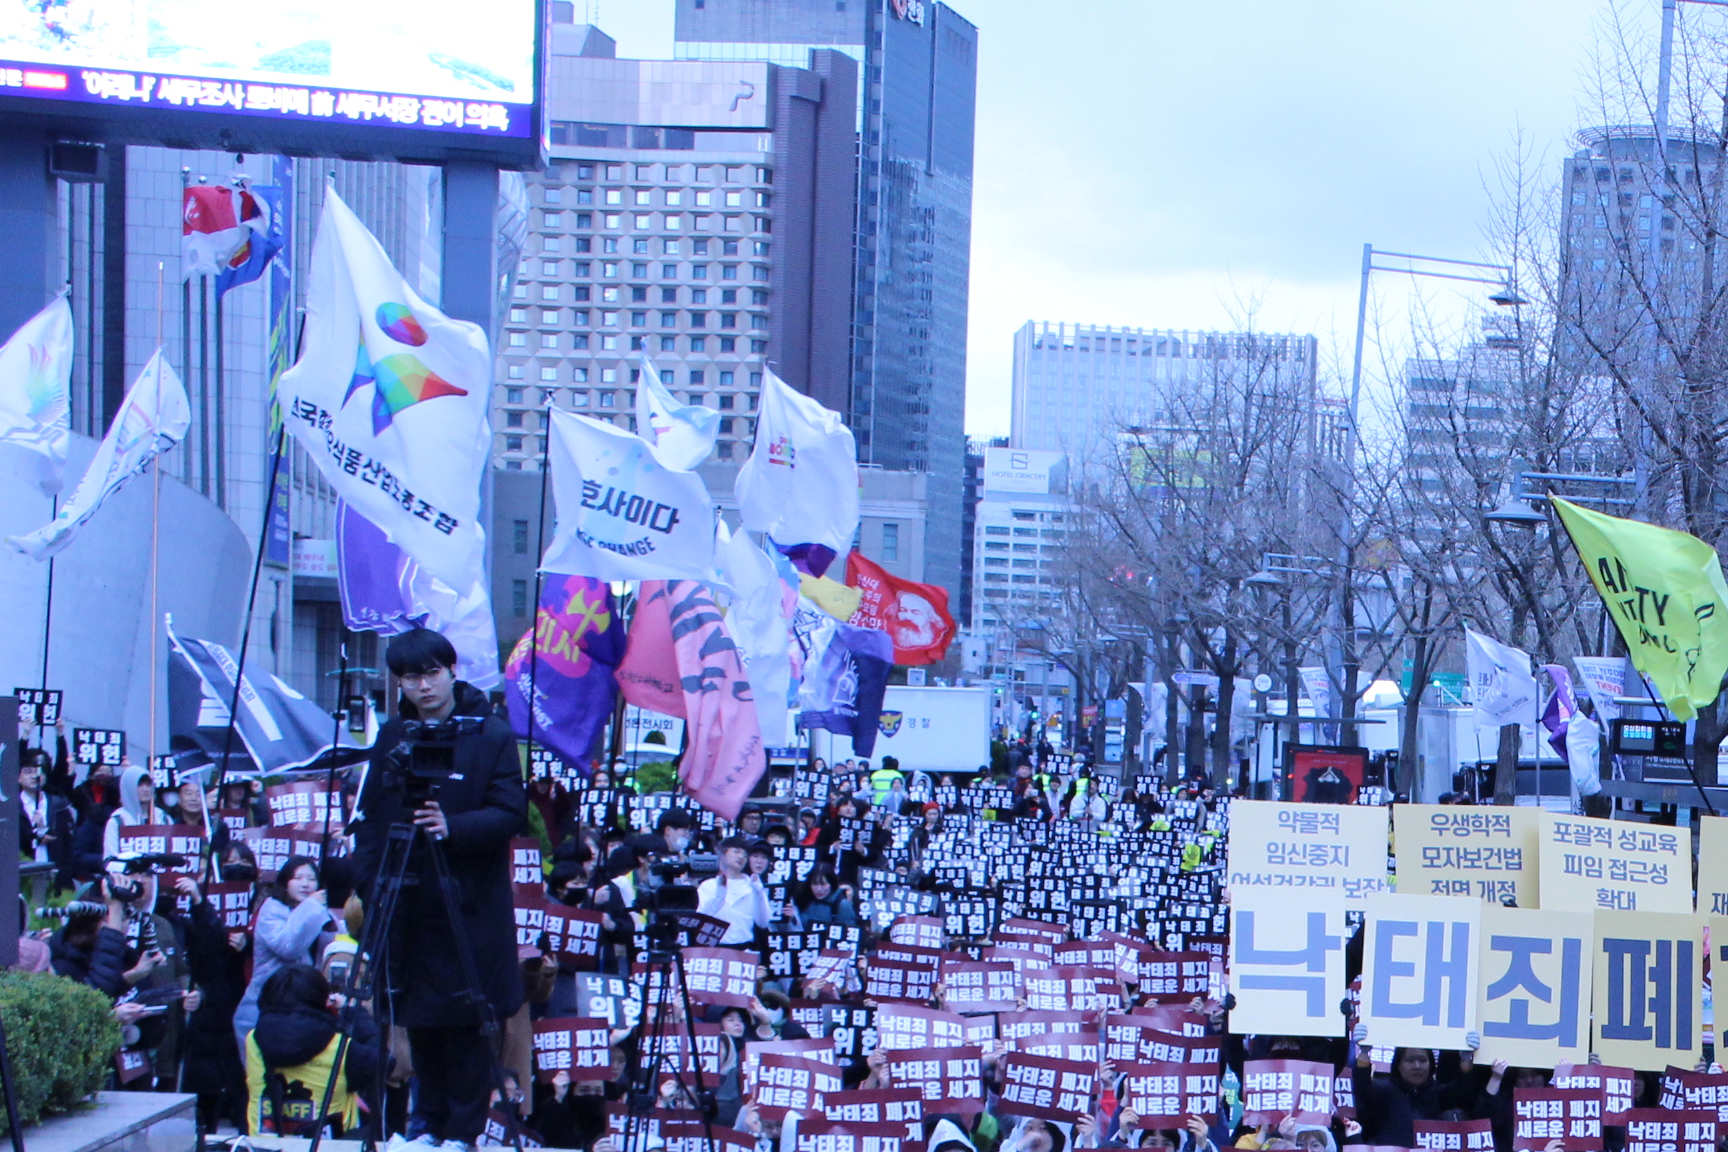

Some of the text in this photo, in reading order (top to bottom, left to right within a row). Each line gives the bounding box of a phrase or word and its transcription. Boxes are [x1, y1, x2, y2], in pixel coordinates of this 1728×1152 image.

[906, 716, 931, 730] 경찰
[79, 731, 121, 744] 낙태죄
[79, 744, 120, 764] 위헌
[1277, 810, 1341, 835] 약물적
[1431, 812, 1511, 836] 우생학적
[1553, 821, 1678, 857] 포괄적 성교육
[1266, 841, 1349, 868] 임신중지
[1422, 844, 1523, 872] 모자보건법
[1564, 854, 1669, 886] 피임 접근성
[1186, 1075, 1217, 1094] 폐지
[1186, 1096, 1217, 1115] 세계
